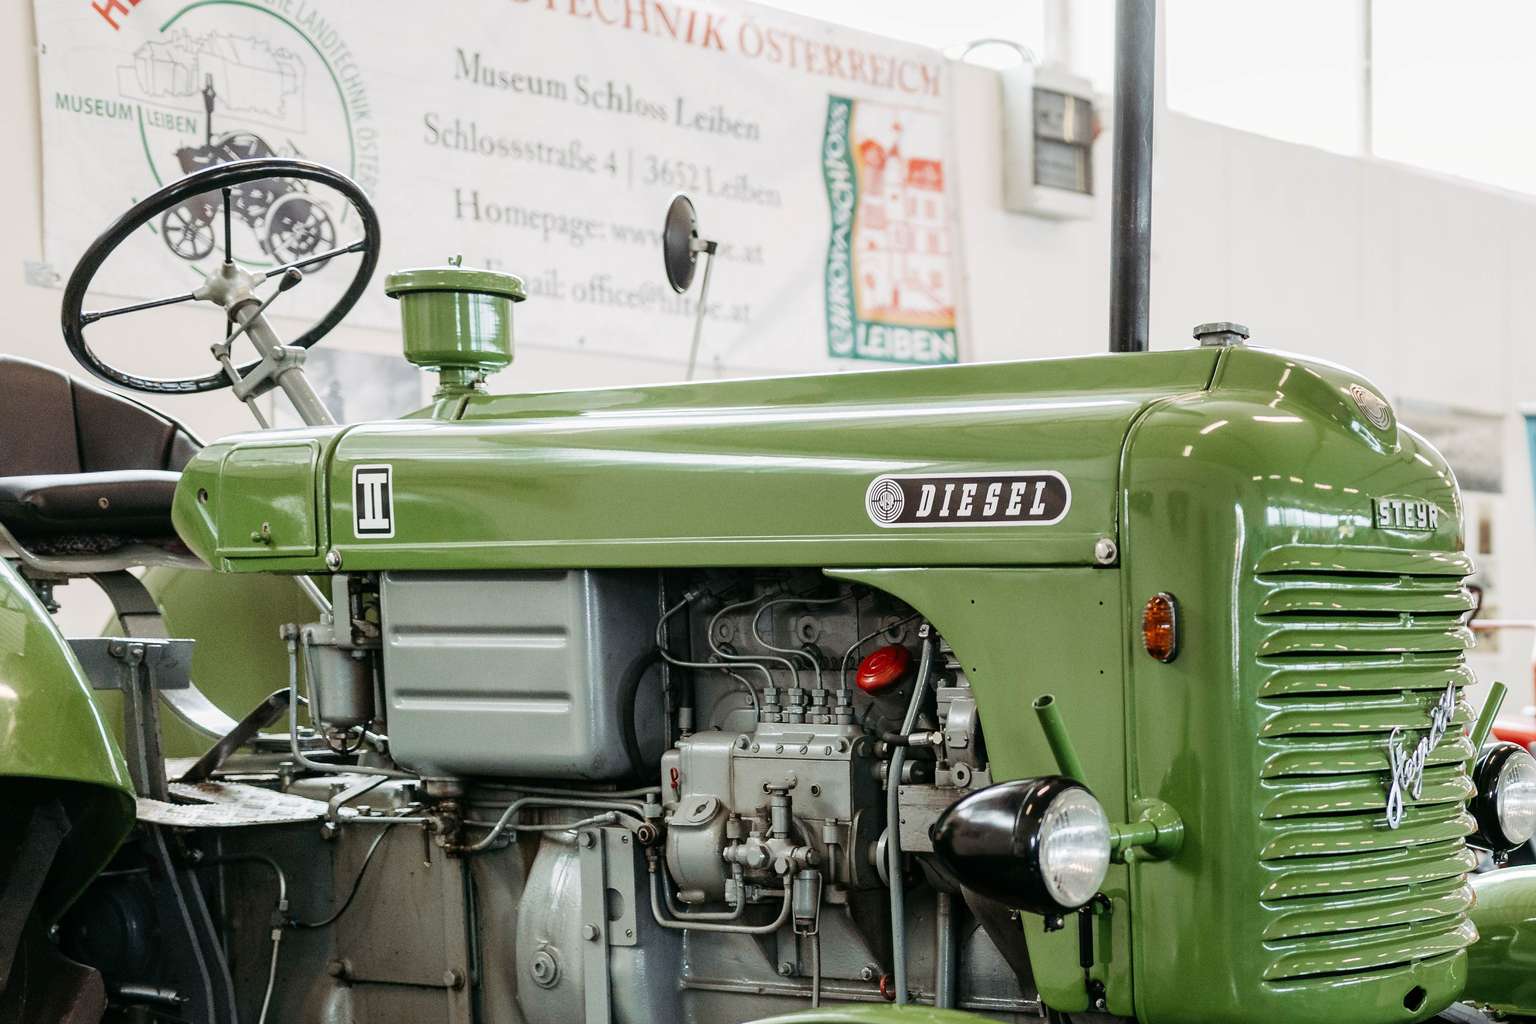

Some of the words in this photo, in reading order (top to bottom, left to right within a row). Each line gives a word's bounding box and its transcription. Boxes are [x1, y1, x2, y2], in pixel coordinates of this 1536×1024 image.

[55, 91, 133, 121] MUSEUM
[146, 111, 198, 135] LEIBEN
[453, 47, 568, 101] Museum
[574, 74, 668, 122] Schloss
[675, 96, 760, 142] Leiben
[604, 150, 617, 176] 4
[453, 188, 606, 247] Homepage:
[857, 324, 956, 360] LEIBEN
[916, 481, 1047, 518] DIESEL
[1378, 500, 1438, 528] STEYR
